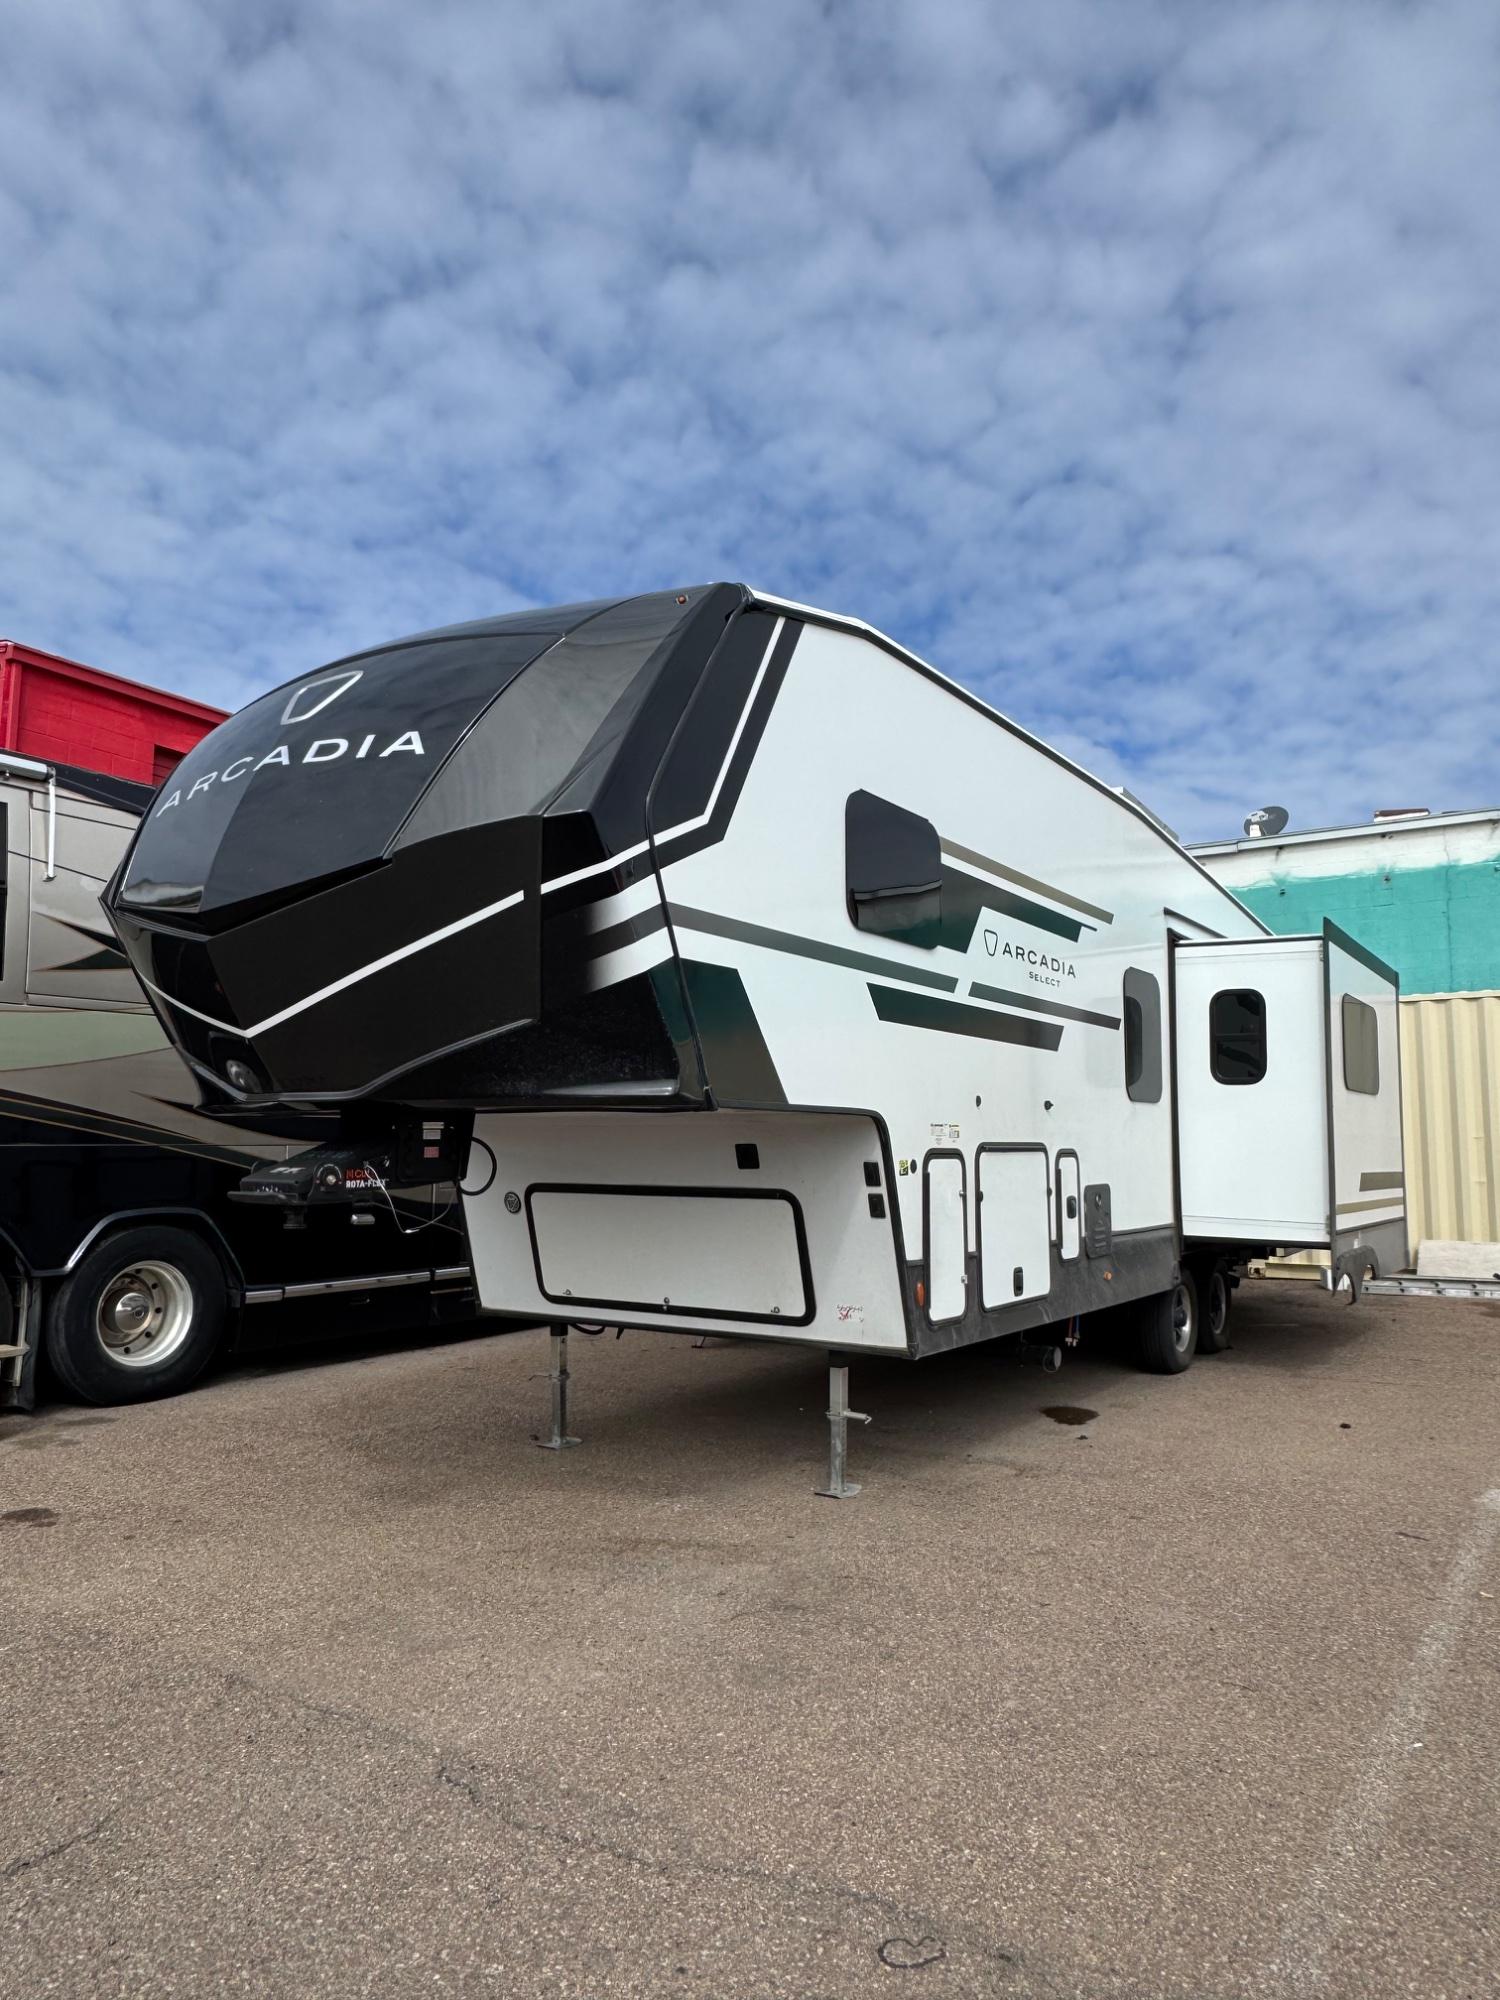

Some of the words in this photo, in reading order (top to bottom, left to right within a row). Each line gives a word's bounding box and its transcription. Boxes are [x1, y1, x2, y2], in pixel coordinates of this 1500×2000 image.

[156, 730, 425, 818] ARCADIA
[1002, 941, 1076, 979] ARCADIA
[1028, 971, 1061, 988] SELECT
